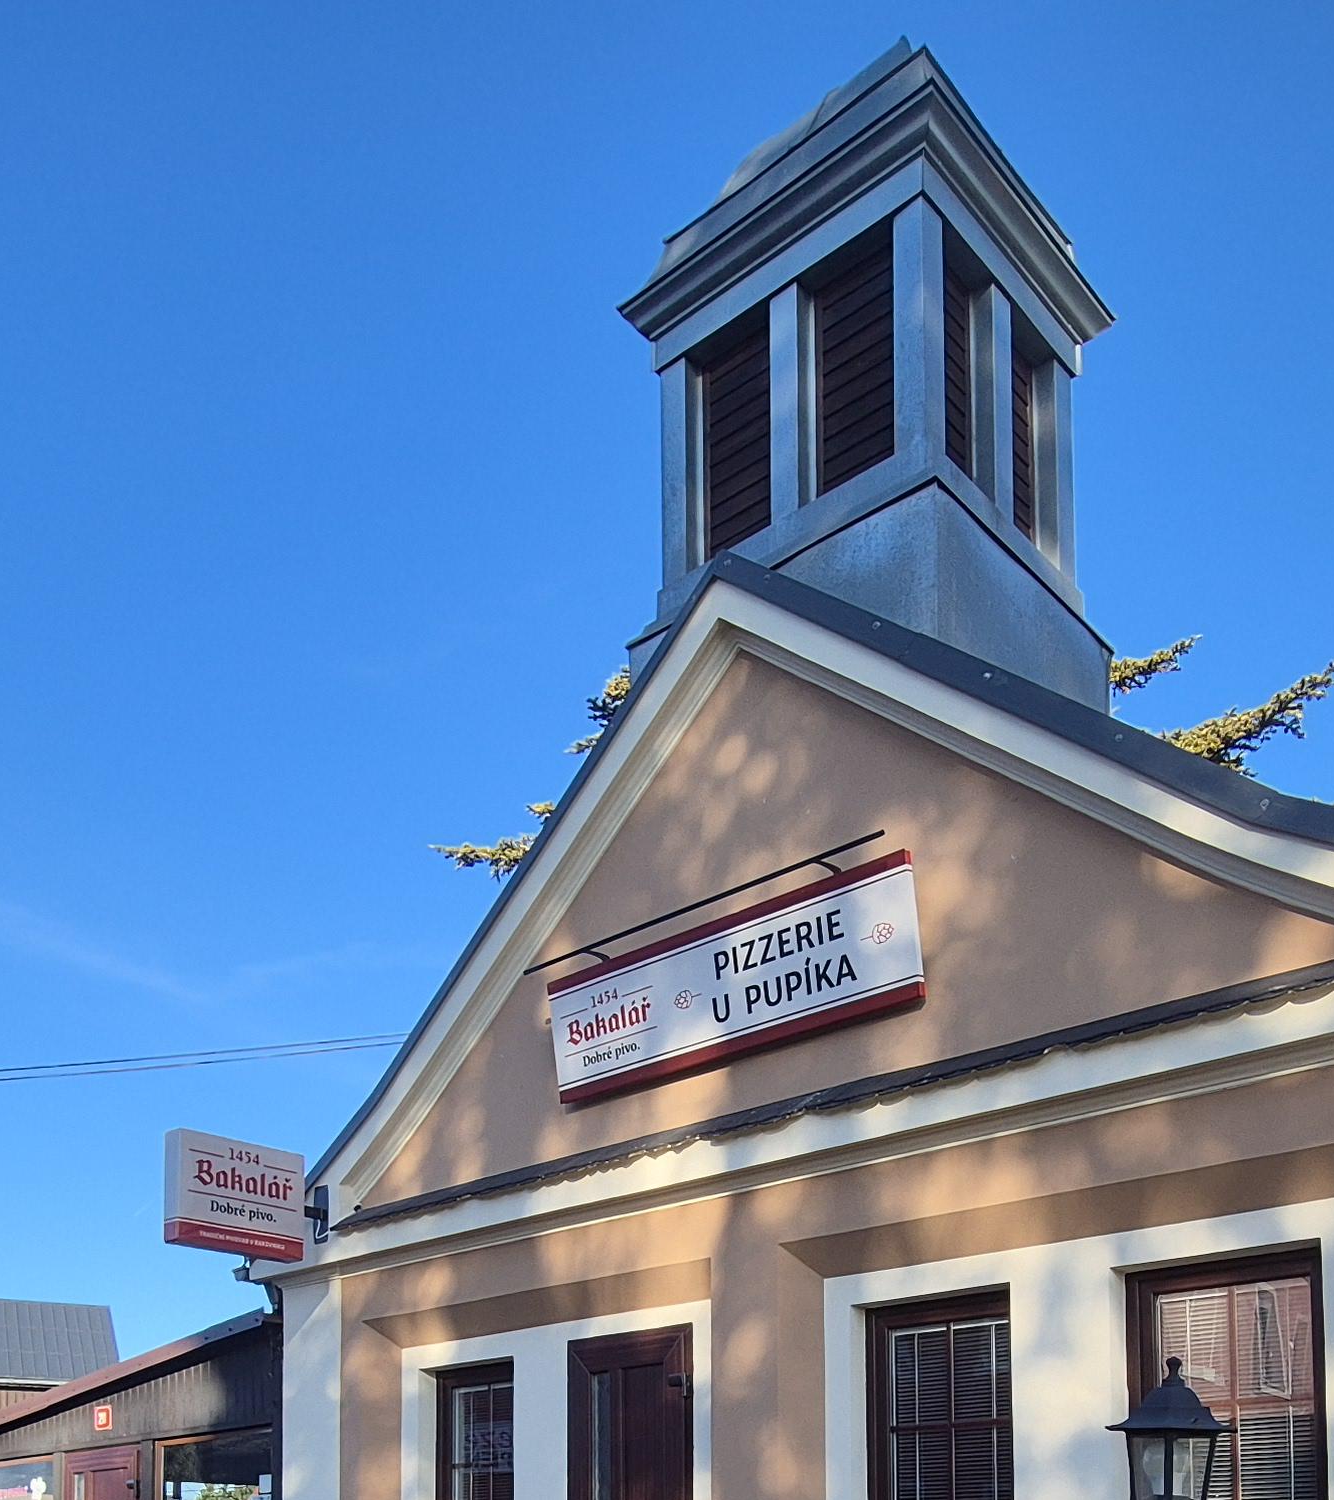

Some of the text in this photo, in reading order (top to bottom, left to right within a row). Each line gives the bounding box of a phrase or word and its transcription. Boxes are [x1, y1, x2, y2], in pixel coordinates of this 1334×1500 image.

[713, 909, 845, 980] PIZZERIE
[590, 988, 619, 1008] 1454
[712, 954, 858, 1023] U PUPÍKA
[566, 995, 651, 1046] Bakalář
[582, 1042, 640, 1067] Dobré pivo.
[229, 1147, 260, 1165] 1454
[193, 1159, 293, 1201] Bakalář
[210, 1200, 277, 1223] Dobré pivo.
